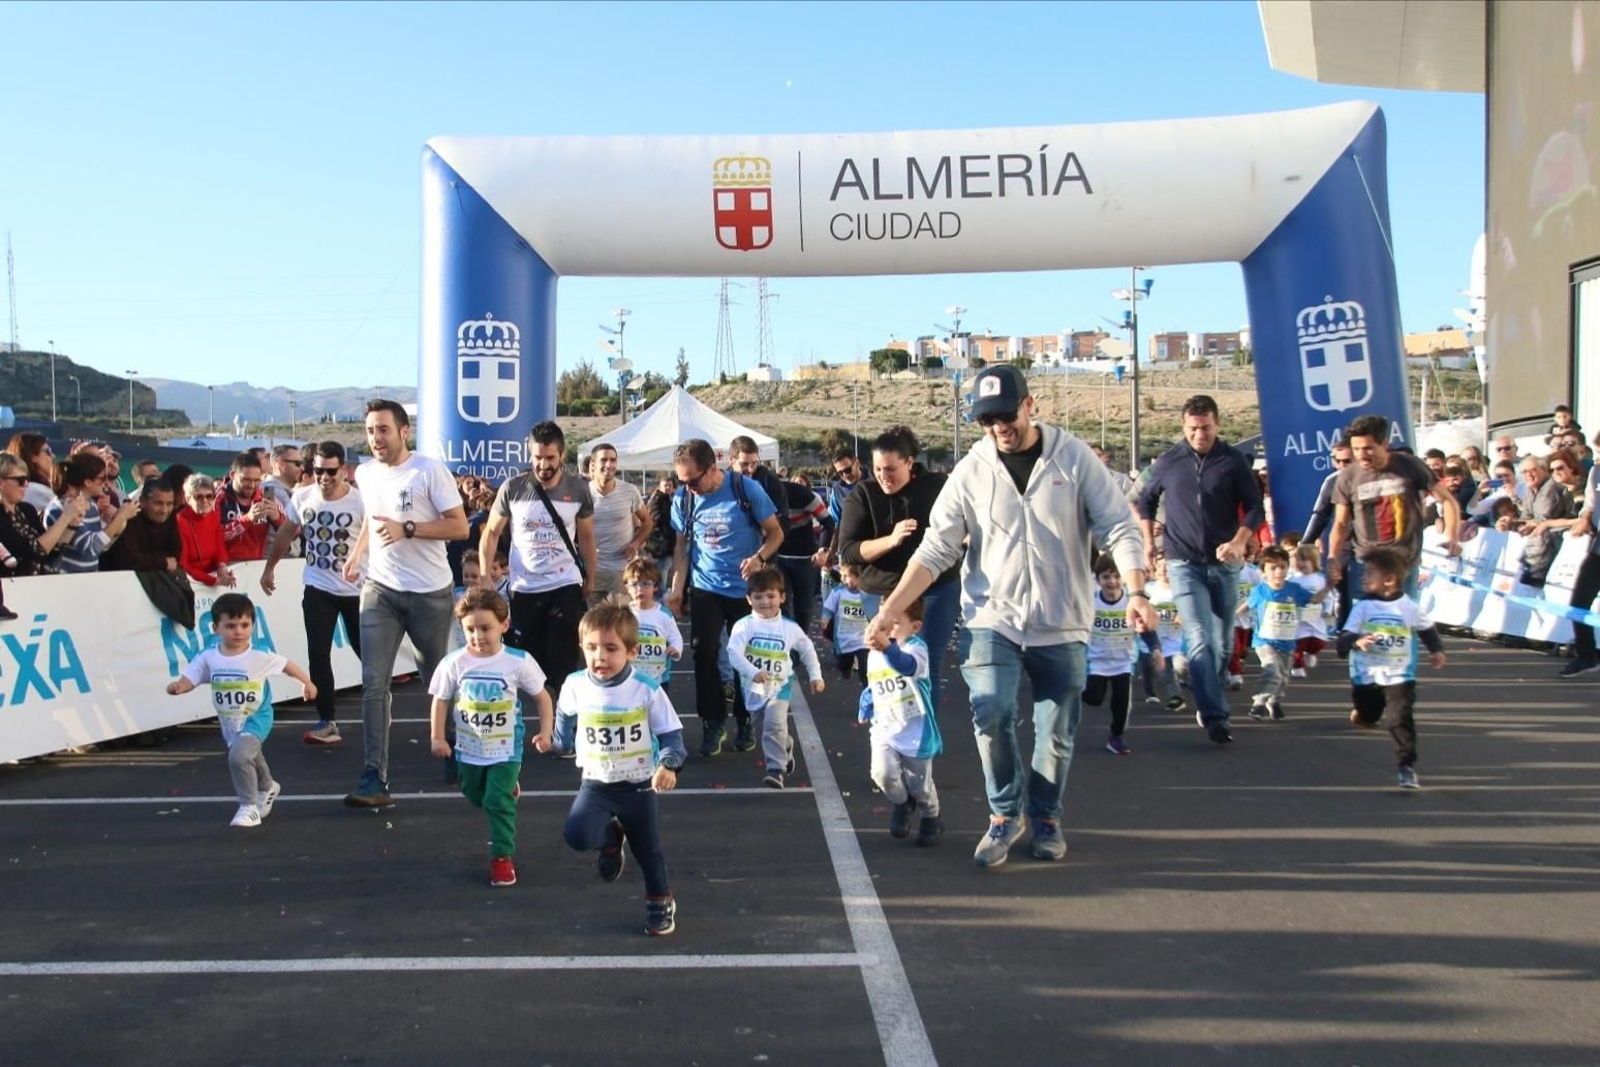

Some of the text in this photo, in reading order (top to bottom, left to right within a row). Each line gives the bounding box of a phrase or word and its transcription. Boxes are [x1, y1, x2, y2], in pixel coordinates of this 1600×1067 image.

[830, 144, 1093, 201] ALMERÍA
[829, 211, 962, 241] CIUDAD
[440, 437, 532, 463] LMERÍ
[215, 691, 256, 705] 8106
[460, 710, 507, 728] 8445
[586, 723, 642, 746] 8315
